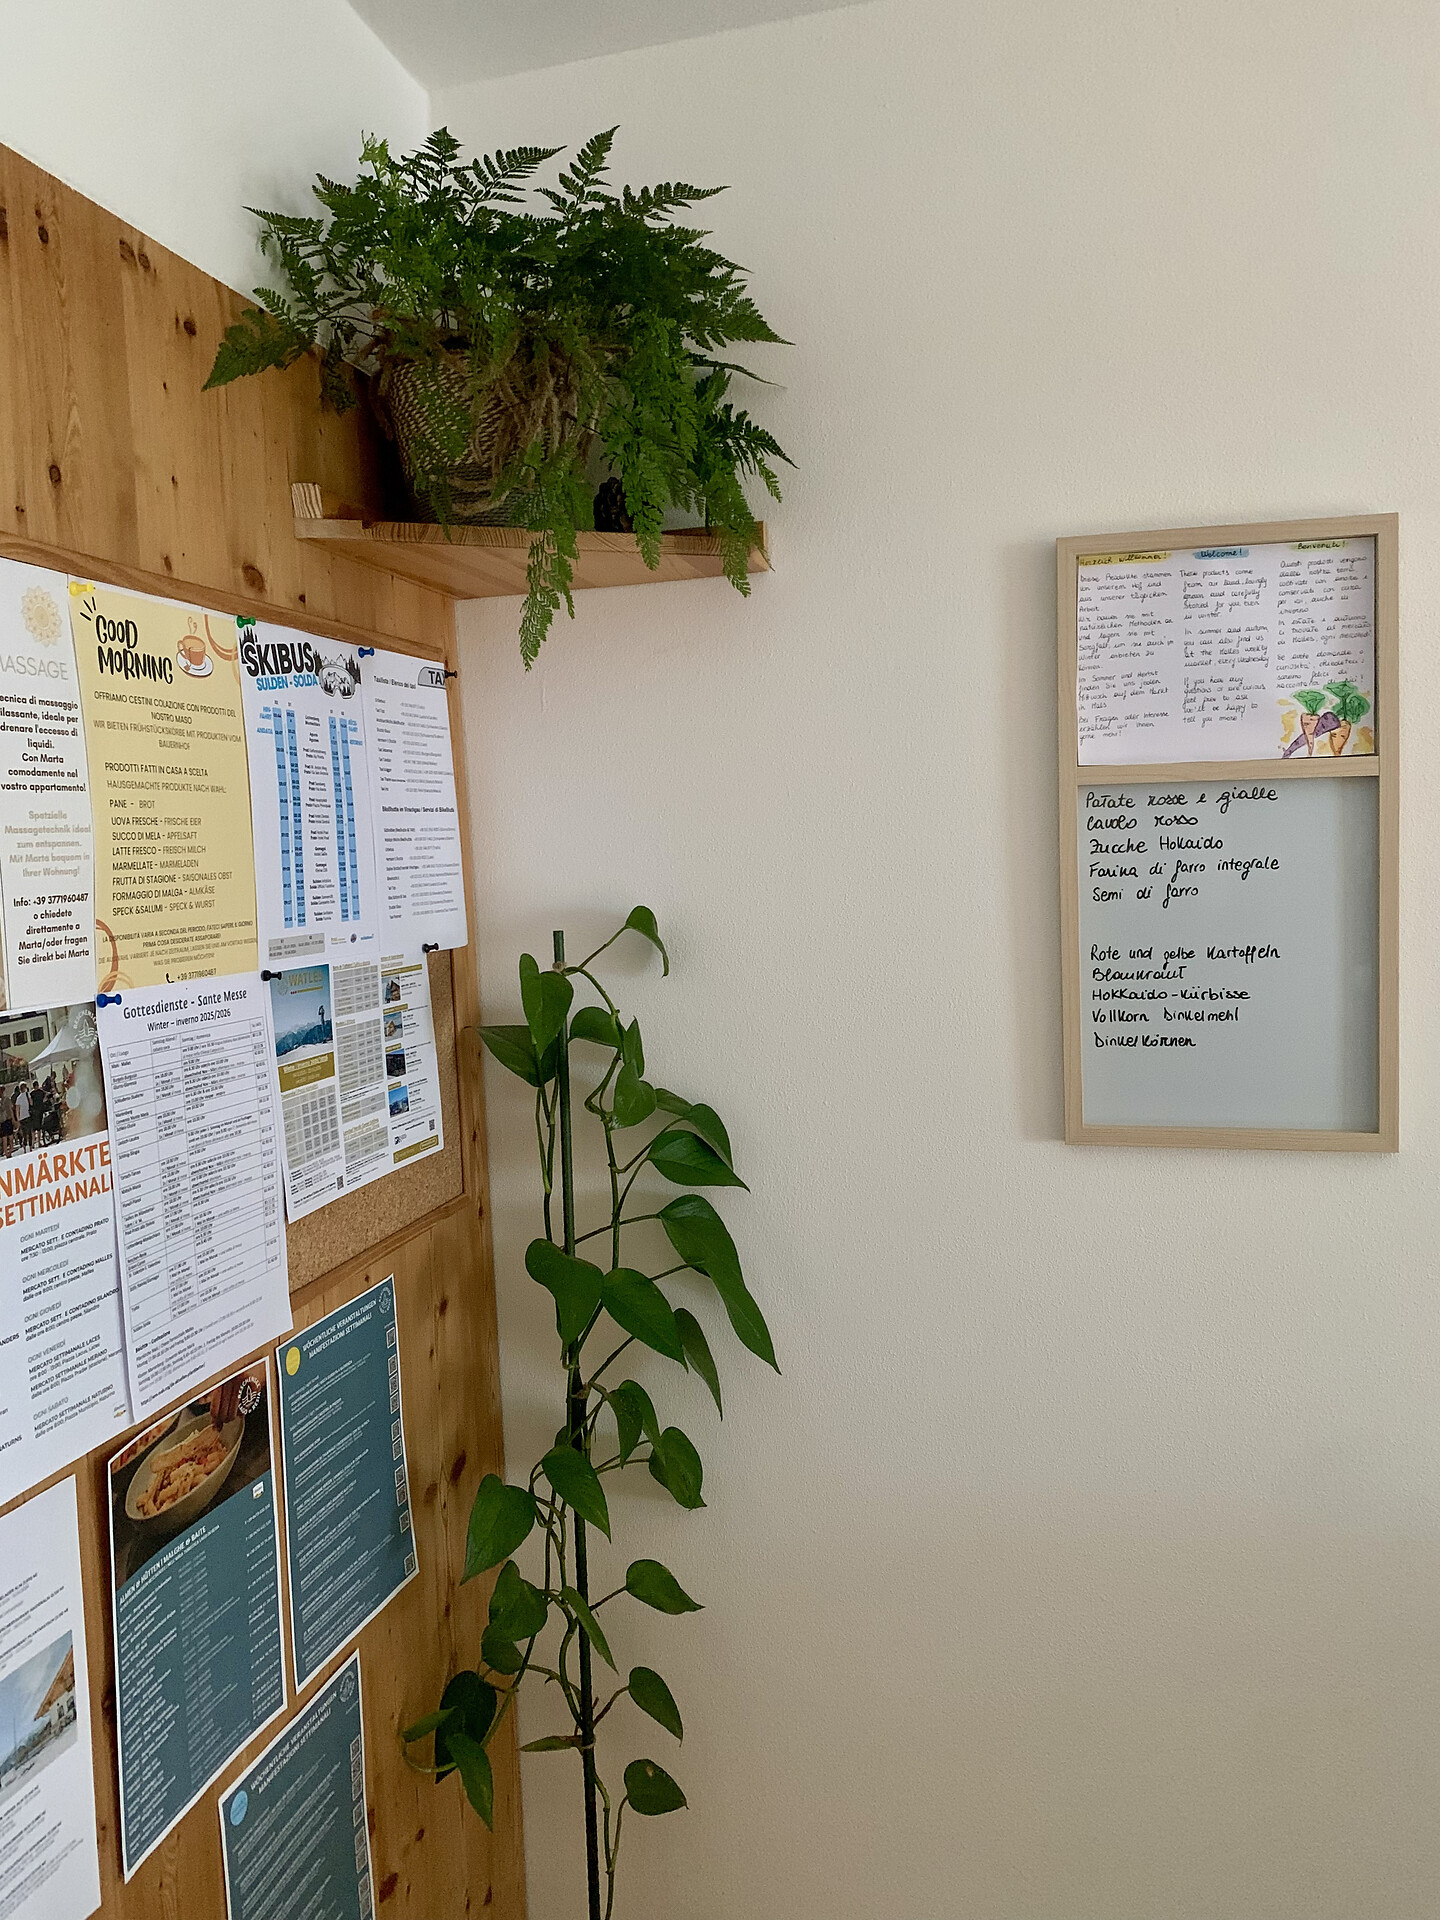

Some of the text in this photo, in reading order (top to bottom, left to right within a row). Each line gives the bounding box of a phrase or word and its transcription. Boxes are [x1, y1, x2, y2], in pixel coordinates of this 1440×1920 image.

[1200, 548, 1242, 557] Welcome!
[1203, 569, 1229, 578] products
[96, 615, 138, 649] GOOD
[97, 645, 173, 684] MORNING
[244, 642, 315, 678] SKIBUS
[256, 673, 318, 692] SULDEN SOLDA
[29, 696, 36, 705] di
[39, 699, 78, 711] massaggio
[94, 691, 236, 717] OFFRIAMO CESTINI COLAZIONE CON PRODOTTI DEL
[42, 712, 65, 722] ideale
[67, 716, 78, 724] per
[151, 712, 192, 724] NOSTRO MASO
[0, 722, 78, 736] drenare l'eccesso di
[28, 738, 55, 750] liquidi.
[159, 740, 190, 750] BAUERNHOF
[22, 753, 64, 763] Con Marta
[8, 767, 78, 778] comodamente nel
[105, 762, 140, 772] PRODOTTI
[140, 764, 158, 773] FATTI
[166, 766, 182, 775] CASA
[189, 768, 208, 776] SCELTA
[0, 782, 86, 793] vostro appartamento!
[107, 780, 160, 790] HAUSGEMACHTE
[162, 782, 193, 791] PRODUKTE
[194, 784, 210, 792] NACH
[110, 799, 155, 808] PANE BROT
[1086, 787, 1279, 814] Patate rosse e gialle
[111, 817, 130, 826] UOVA
[132, 817, 158, 826] FRESCHE
[164, 818, 188, 826] FRISCHE
[1154, 815, 1199, 827] rosso
[4, 825, 70, 836] Massagetechnik
[112, 832, 136, 841] SUCCO
[137, 832, 144, 840] DI
[36, 841, 82, 851] entspannen.
[112, 847, 131, 856] LATTE
[132, 846, 156, 855] FRESCO
[187, 845, 206, 853] MILCH
[1089, 838, 1148, 855] Zucche
[9, 854, 23, 863] Mit
[51, 853, 81, 864] bequem
[112, 860, 198, 871] MARMELLATE MARMELADEN
[23, 866, 80, 877] Ihrer Wohnung!
[1089, 857, 1280, 883] Farina di farro integrale
[112, 872, 232, 886] FRUTTA DI STAGIONE SAISONALES OBST
[14, 897, 31, 907] Info:
[48, 893, 88, 904] 3771960487
[112, 885, 215, 901] FORMAGGIO DI MALGA ALMKÄSE
[1092, 883, 1199, 909] Semi di farro
[40, 910, 72, 919] chiedete
[112, 907, 134, 916] SPECK
[169, 902, 188, 911] SPECK
[195, 900, 215, 908] WURST
[26, 925, 73, 935] direttamente
[19, 936, 87, 950] Marta/oder fragen
[18, 949, 89, 965] Sie direkt bei Marta
[1090, 944, 1281, 970] Rote und gelbe Kartoffeln
[1092, 965, 1188, 982] Blaukraut
[123, 989, 247, 1019] Gottesdienste Sante Messe
[147, 1008, 231, 1031] Winter inverno 2025/2026
[1092, 1006, 1240, 1023] Vollkorn Dinkelmehl
[20, 1242, 45, 1254] MERCATO
[65, 1224, 93, 1238] CONTADINO
[94, 1218, 109, 1227] PRATO
